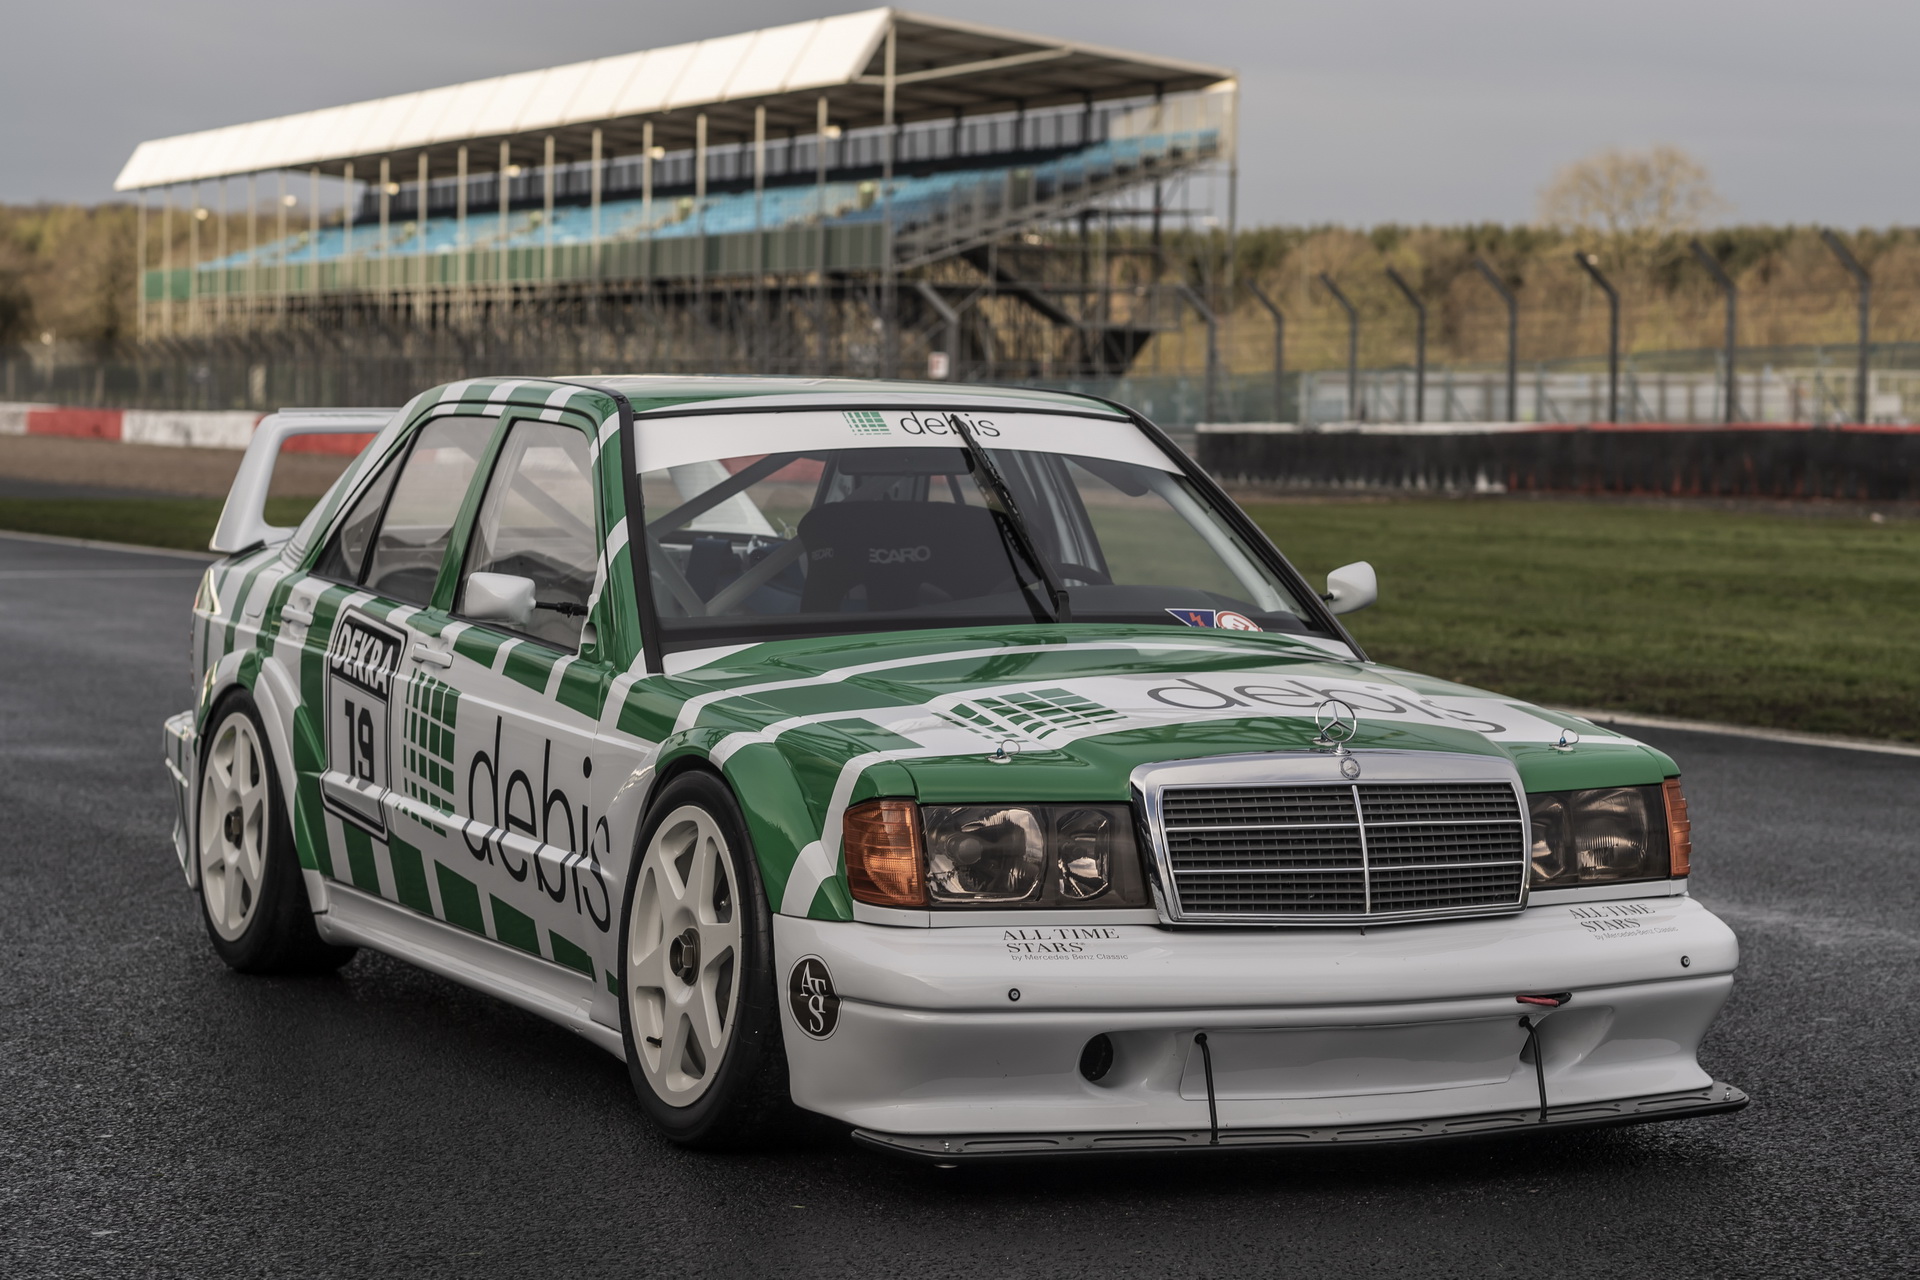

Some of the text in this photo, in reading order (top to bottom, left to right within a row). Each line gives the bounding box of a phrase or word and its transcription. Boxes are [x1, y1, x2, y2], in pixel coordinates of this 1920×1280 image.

[900, 411, 1000, 437] debis
[331, 623, 393, 694] DEKRA
[1147, 678, 1506, 734] debis
[344, 699, 375, 785] 19
[462, 715, 611, 933] debis
[1003, 928, 1119, 940] ALL TIME
[1569, 904, 1655, 919] ALL TIME
